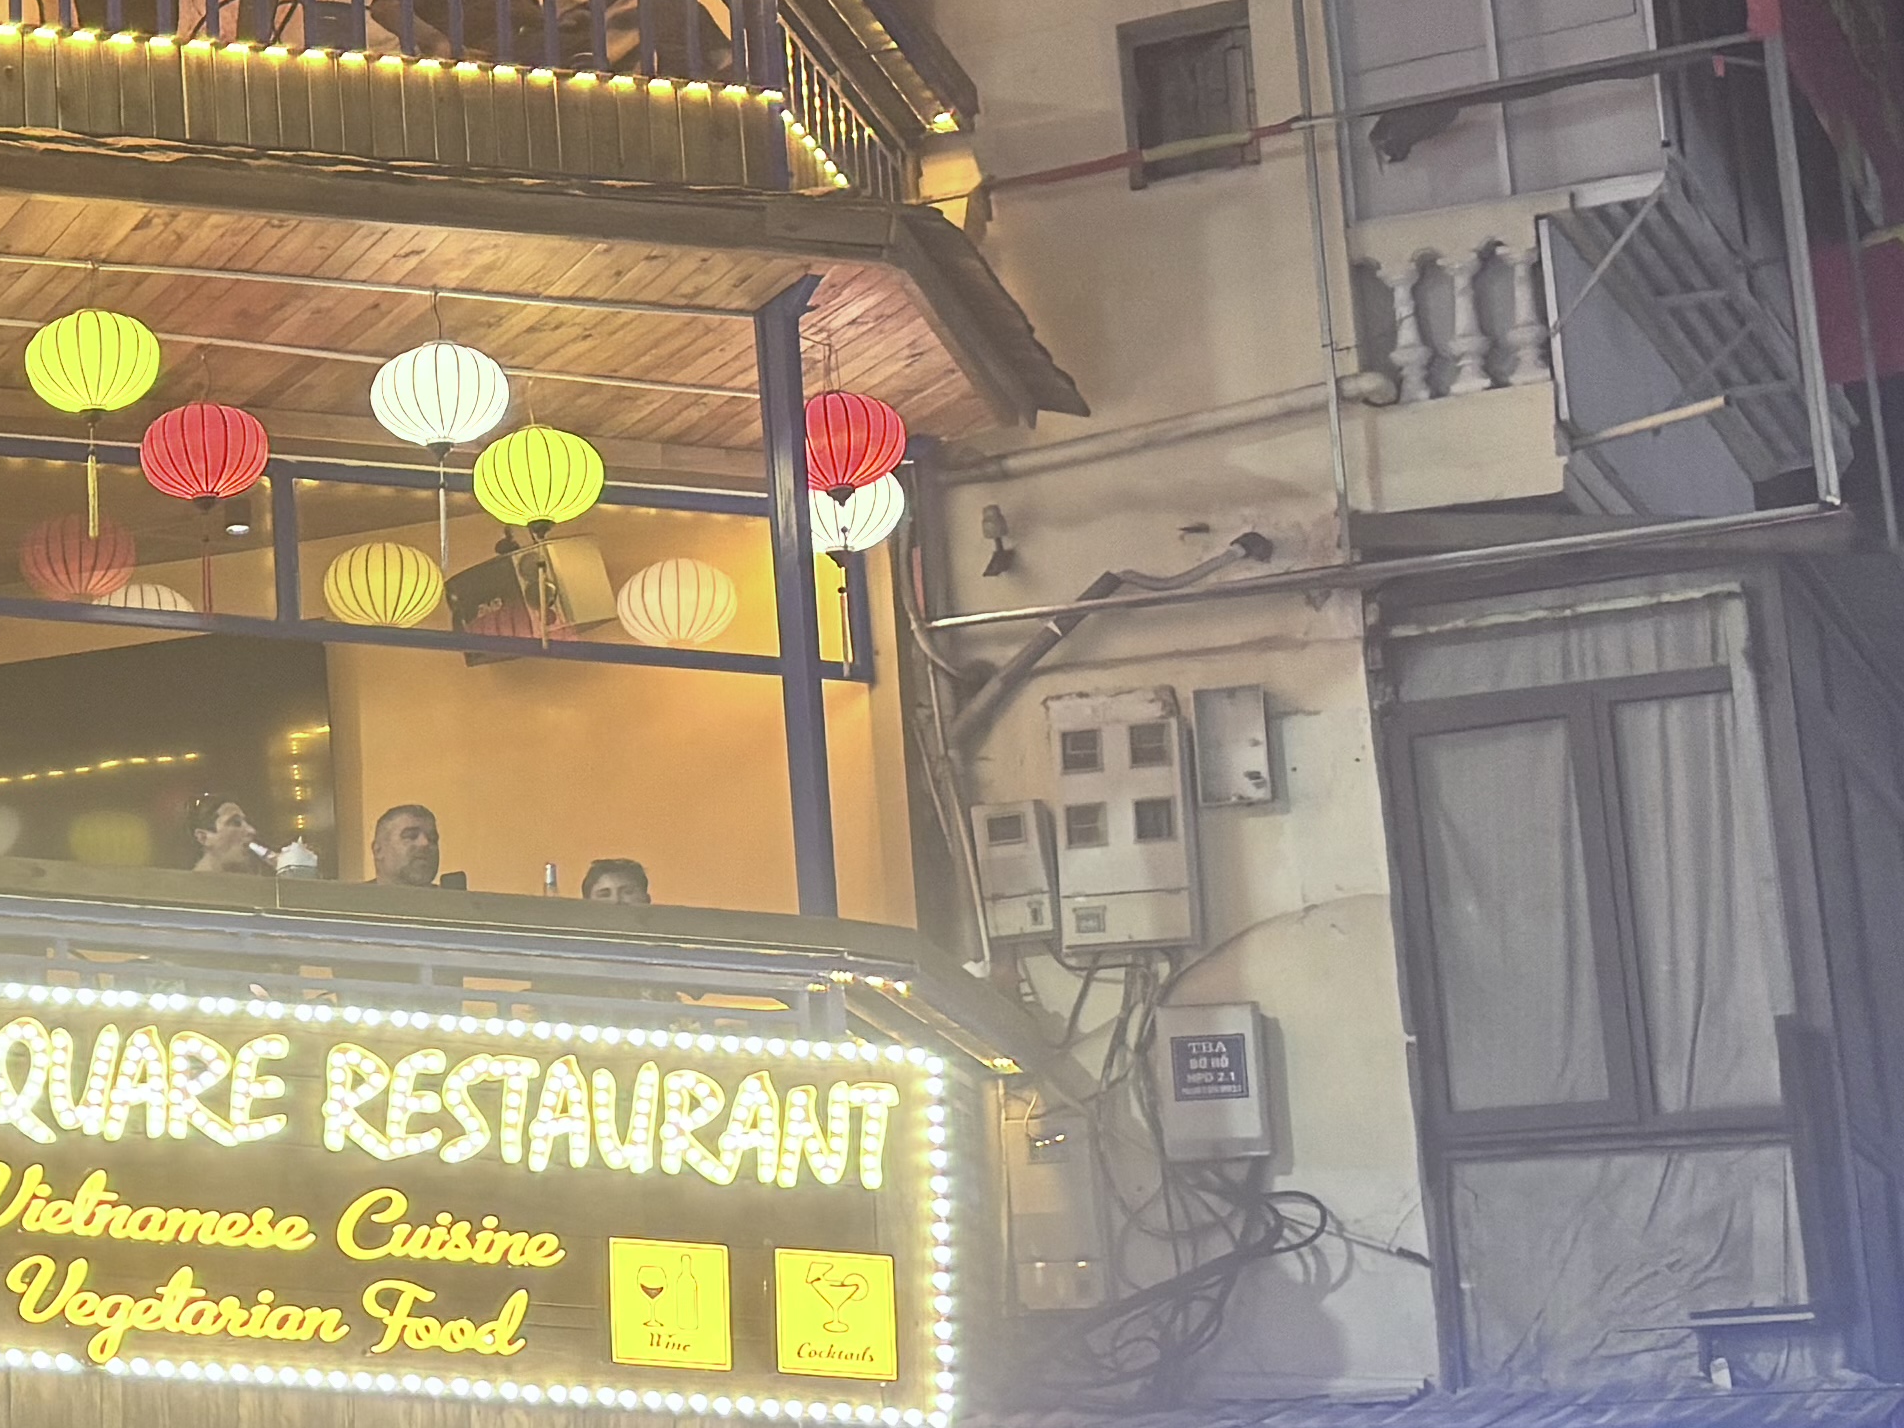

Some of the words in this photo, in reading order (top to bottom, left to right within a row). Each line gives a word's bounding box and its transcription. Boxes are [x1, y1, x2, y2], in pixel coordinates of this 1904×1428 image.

[1188, 1041, 1227, 1053] TBA
[322, 1042, 900, 1192] RESTAURANT
[334, 1186, 568, 1272] Cuisine
[4, 1254, 349, 1368] Vegetarian
[360, 1278, 530, 1360] Food
[649, 1332, 692, 1353] Wine
[796, 1341, 875, 1363] Cocktails
